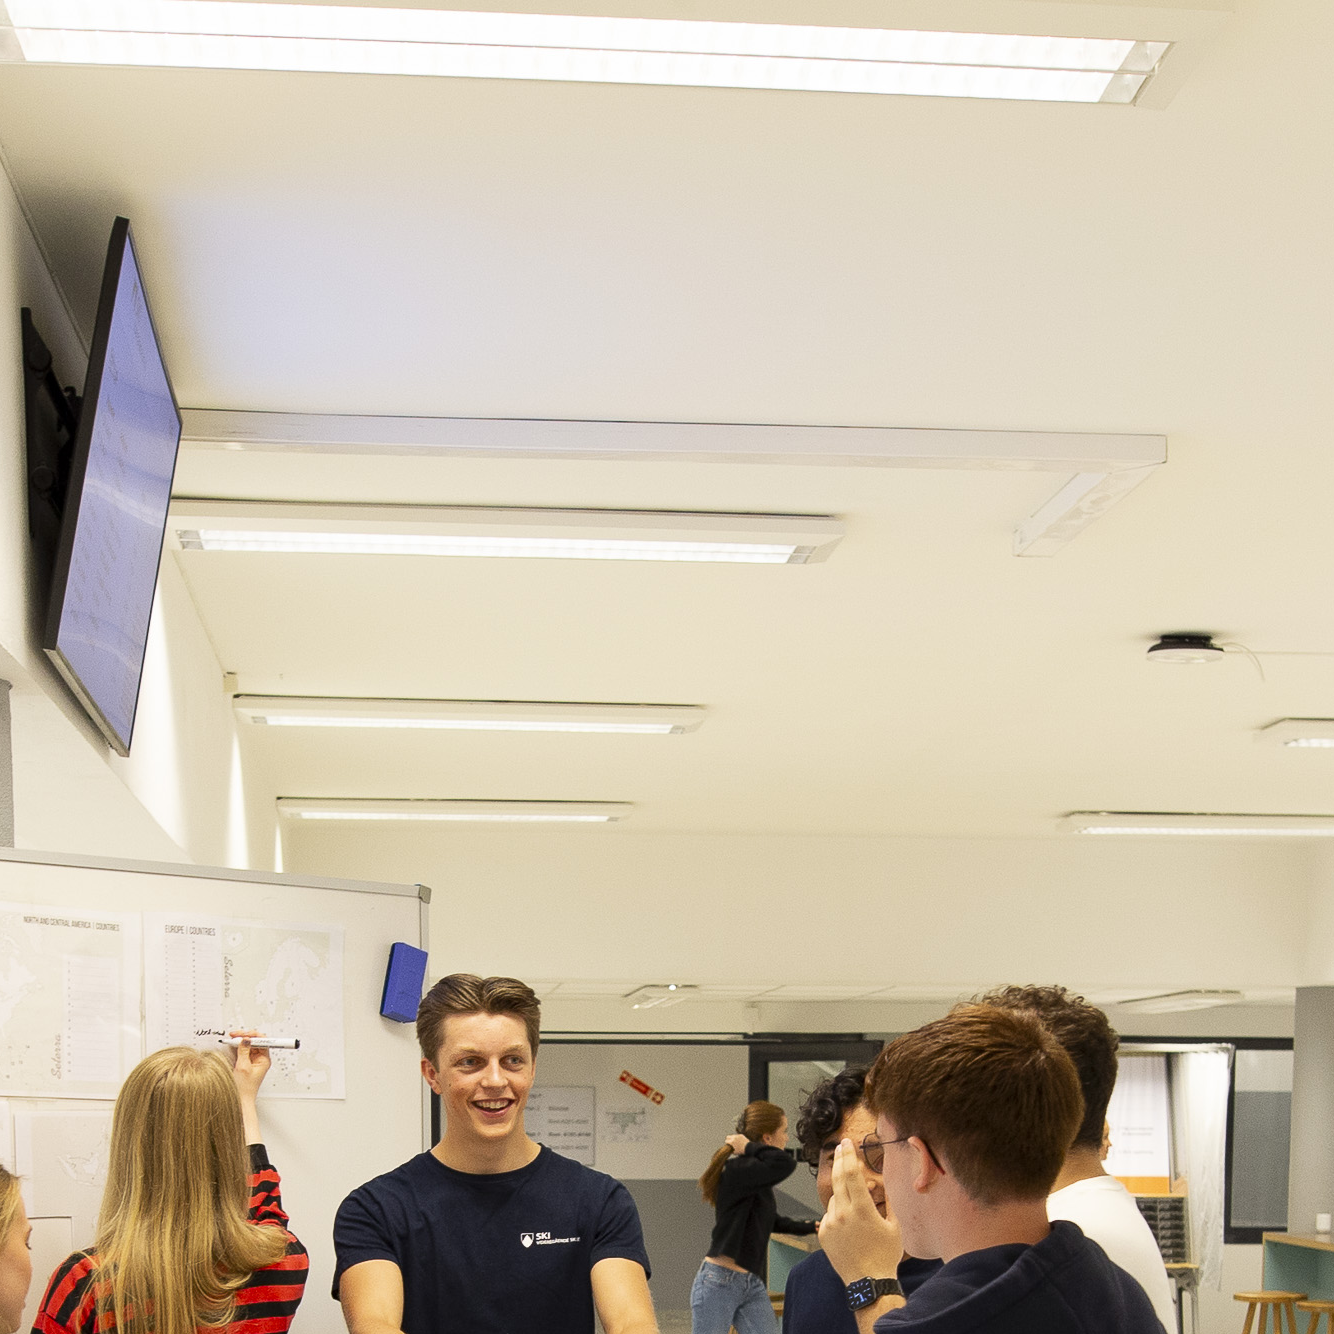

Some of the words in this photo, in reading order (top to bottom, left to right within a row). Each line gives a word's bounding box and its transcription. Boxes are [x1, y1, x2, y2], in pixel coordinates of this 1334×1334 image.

[39, 917, 49, 926] AND
[71, 919, 91, 929] AMERICA
[95, 922, 120, 931] COUNTRIES
[164, 924, 185, 934] EUROPE
[189, 926, 216, 936] COUNTRIES
[535, 1232, 551, 1240] SKI
